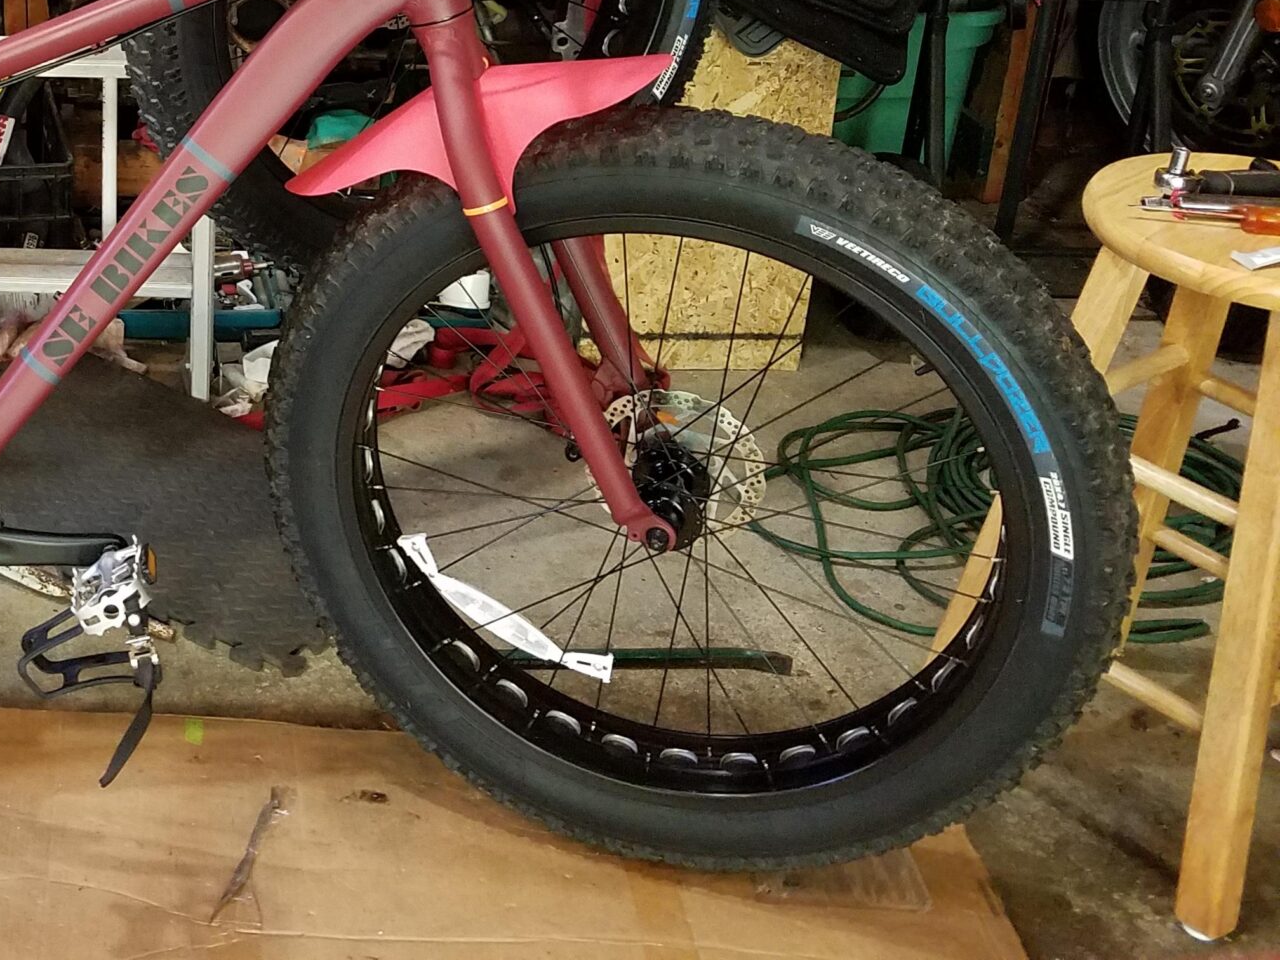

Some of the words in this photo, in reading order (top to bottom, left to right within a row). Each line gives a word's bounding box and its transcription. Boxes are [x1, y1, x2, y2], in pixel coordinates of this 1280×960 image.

[41, 303, 98, 367] SE
[89, 166, 209, 305] BIKES
[835, 237, 911, 284] VEETIRECO
[915, 283, 1053, 455] BULLDOZER
[1042, 480, 1061, 551] COMPOUND
